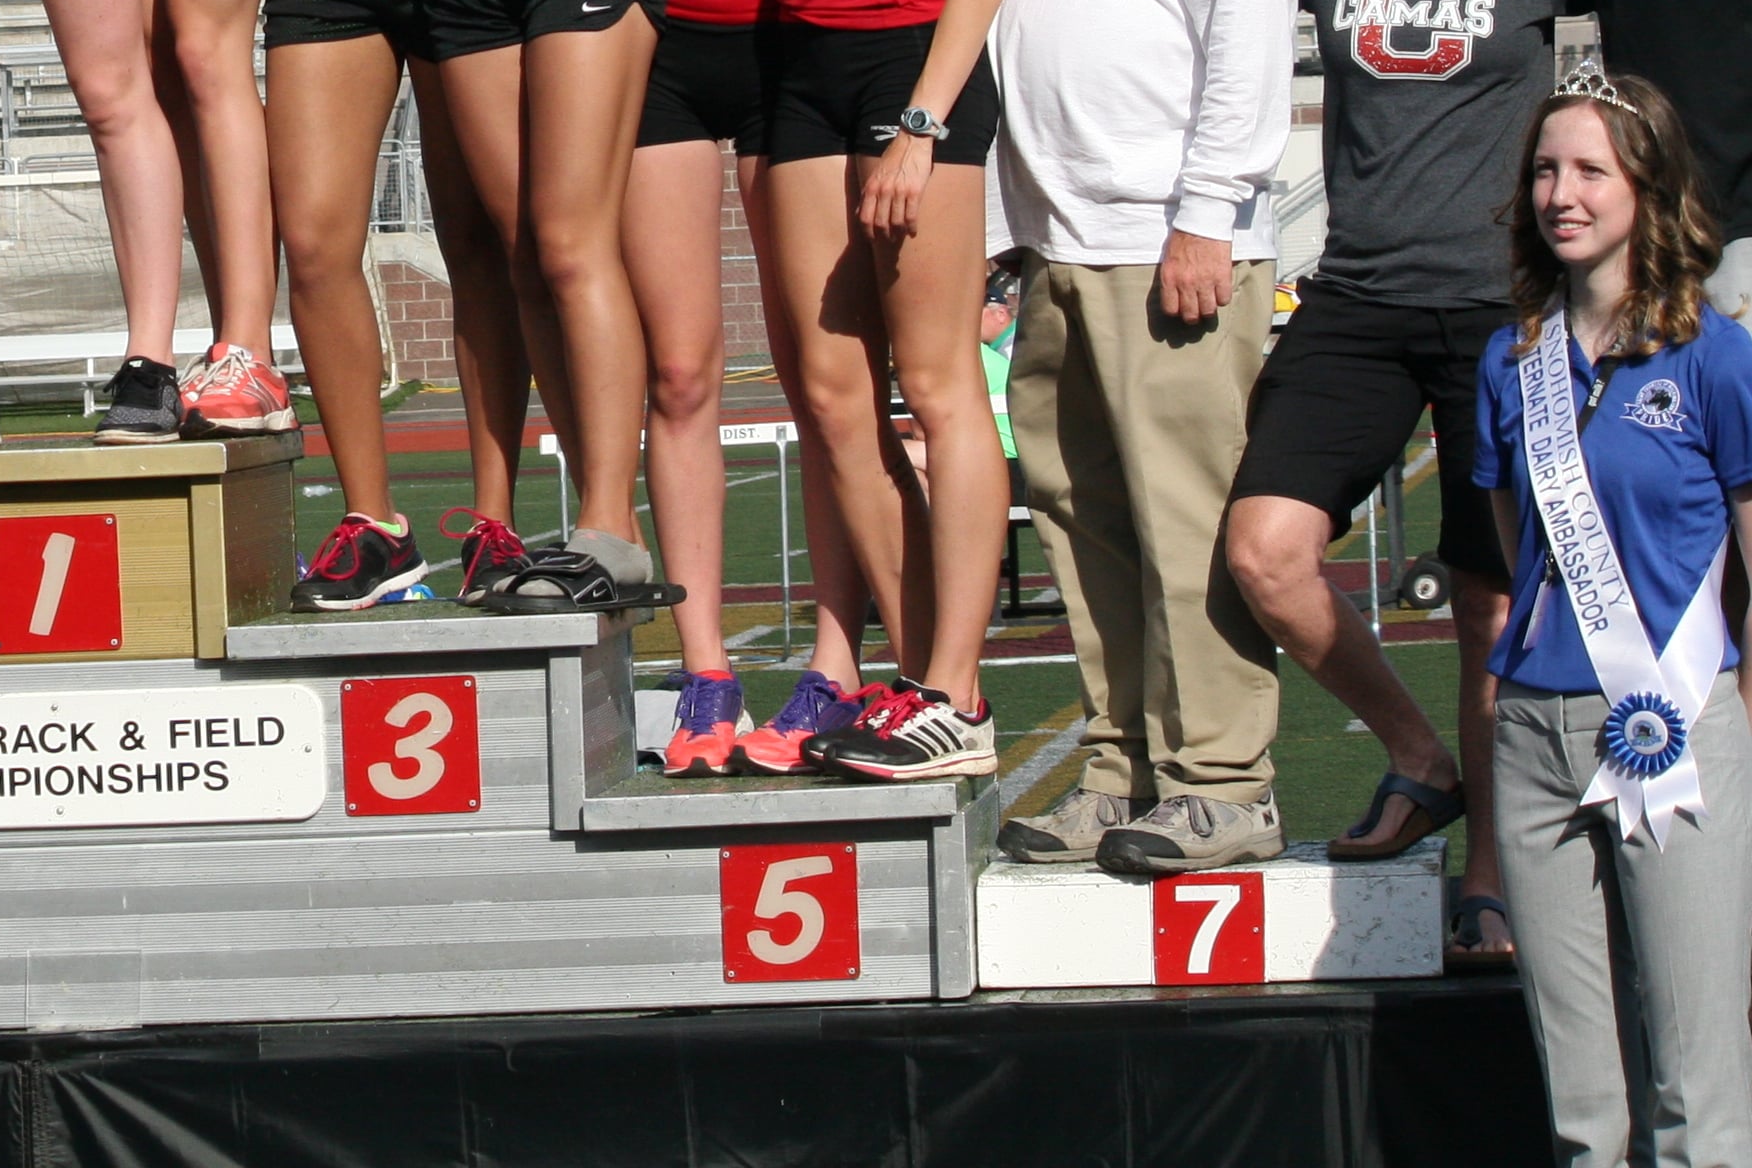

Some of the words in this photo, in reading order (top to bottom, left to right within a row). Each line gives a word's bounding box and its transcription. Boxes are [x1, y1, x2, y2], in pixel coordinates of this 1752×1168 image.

[723, 427, 760, 440] DIST.
[1545, 323, 1583, 486] SNOHOMISH
[1531, 436, 1562, 494] DAIRY
[29, 532, 76, 636] 1
[1544, 499, 1610, 636] AMBASSADOR
[1572, 491, 1631, 609] COUNTY
[118, 720, 147, 752] &
[169, 716, 286, 750] FIELD
[367, 692, 454, 801] 3
[745, 855, 835, 965] 5
[1174, 884, 1241, 975] 7
